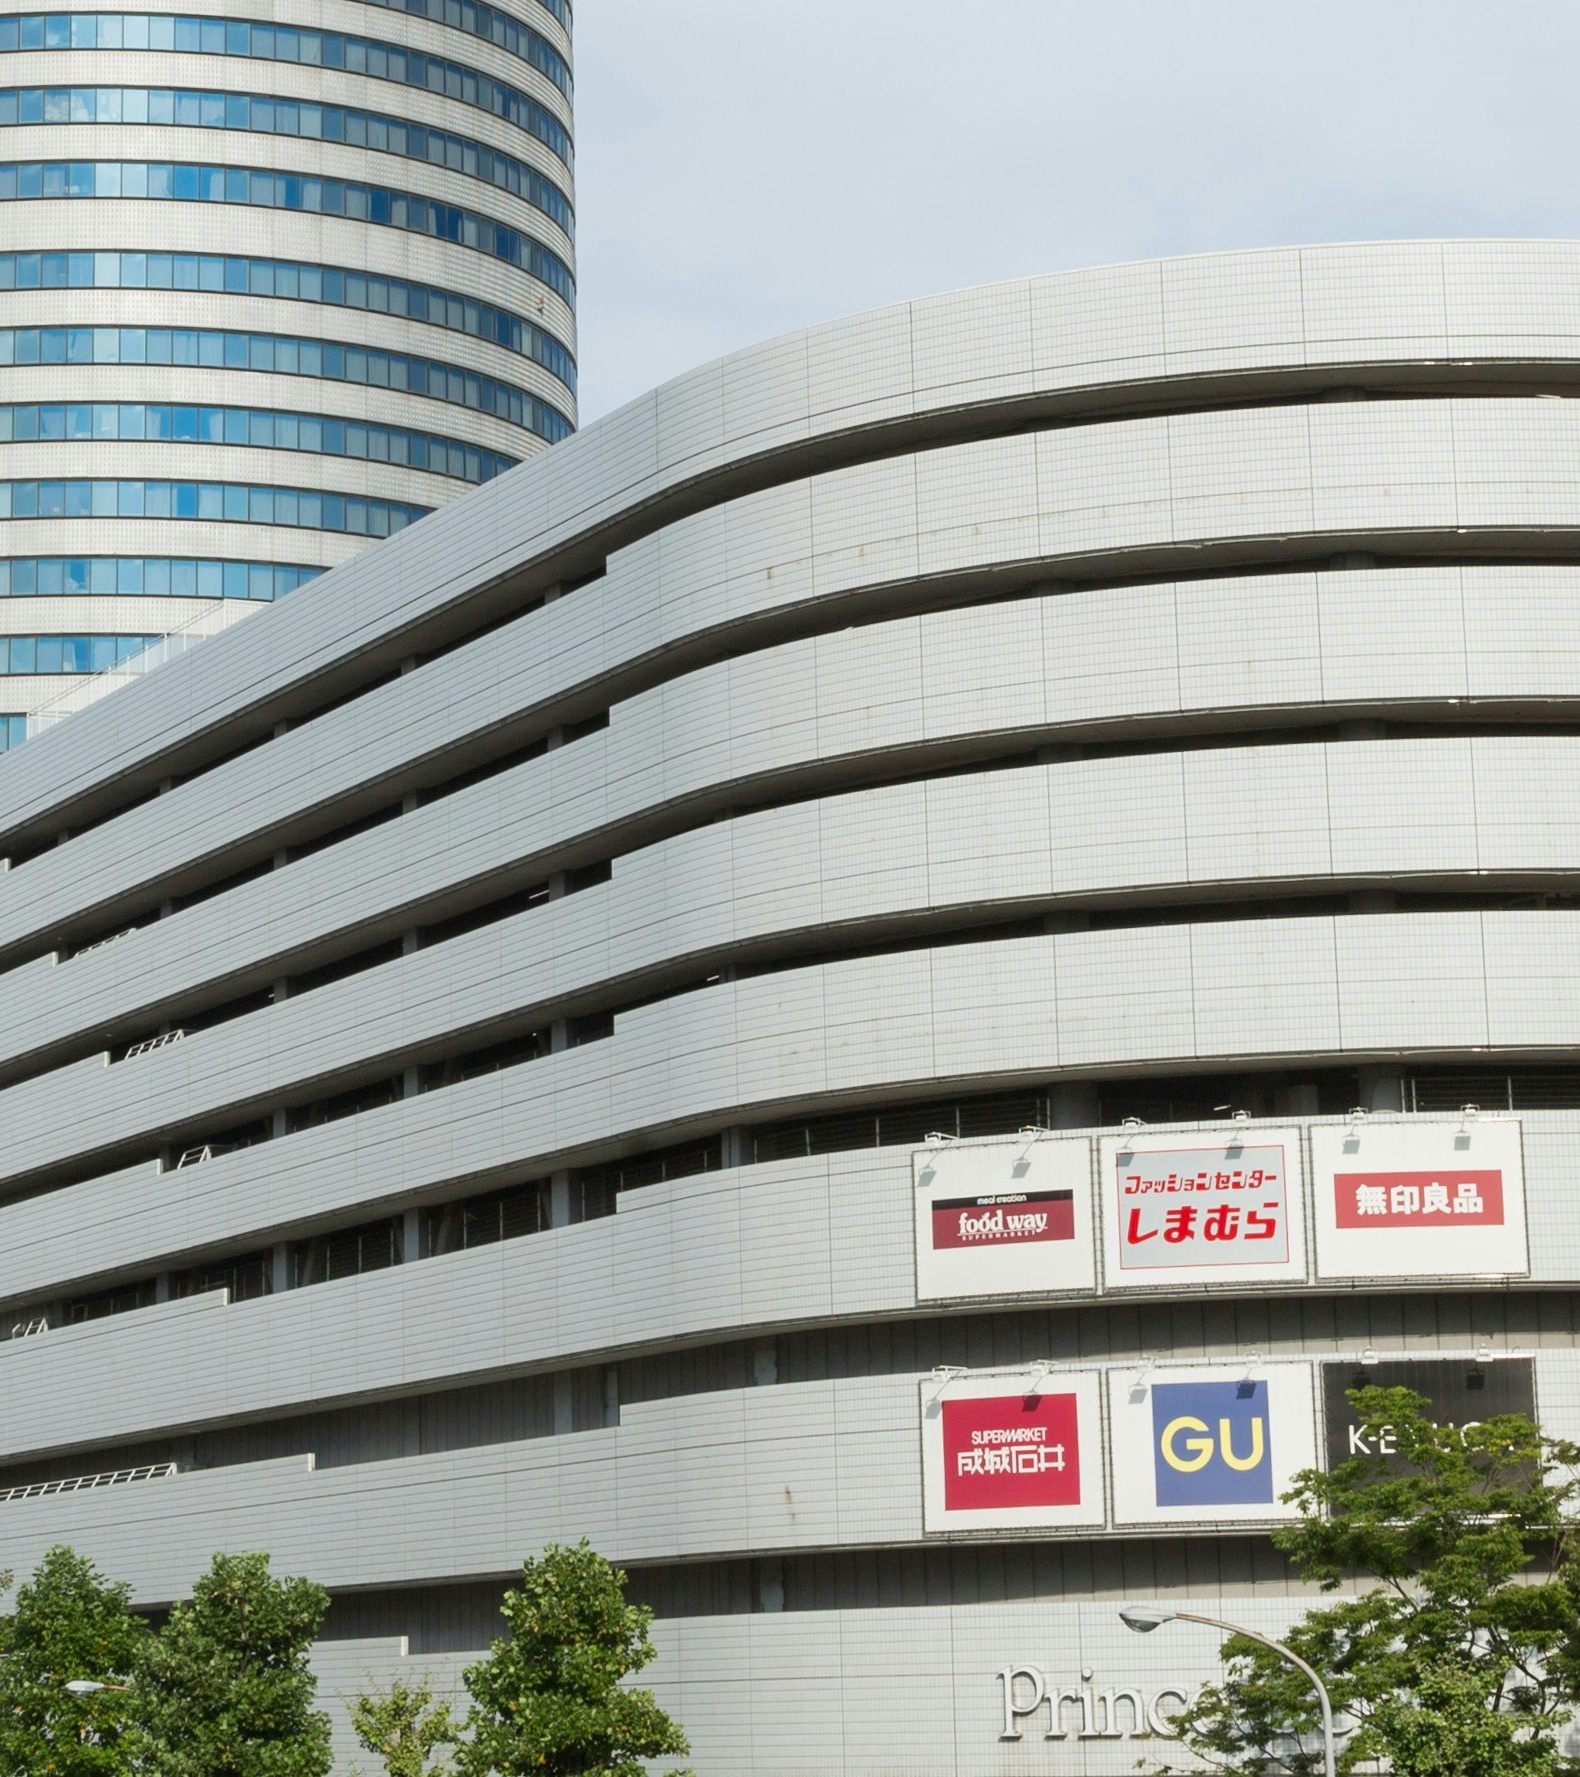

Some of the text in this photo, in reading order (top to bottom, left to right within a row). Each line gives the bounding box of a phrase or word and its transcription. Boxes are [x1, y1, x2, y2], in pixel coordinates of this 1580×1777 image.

[1125, 1170, 1277, 1194] ファッションセンター
[1355, 1182, 1484, 1216] 無印良品
[962, 1230, 1036, 1241] SUPERMARKET
[1006, 1213, 1049, 1233] way
[1127, 1202, 1279, 1245] しまむら
[971, 1427, 1047, 1445] SUPERMARKET
[1161, 1416, 1264, 1472] GU
[957, 1444, 1066, 1477] 成城石井
